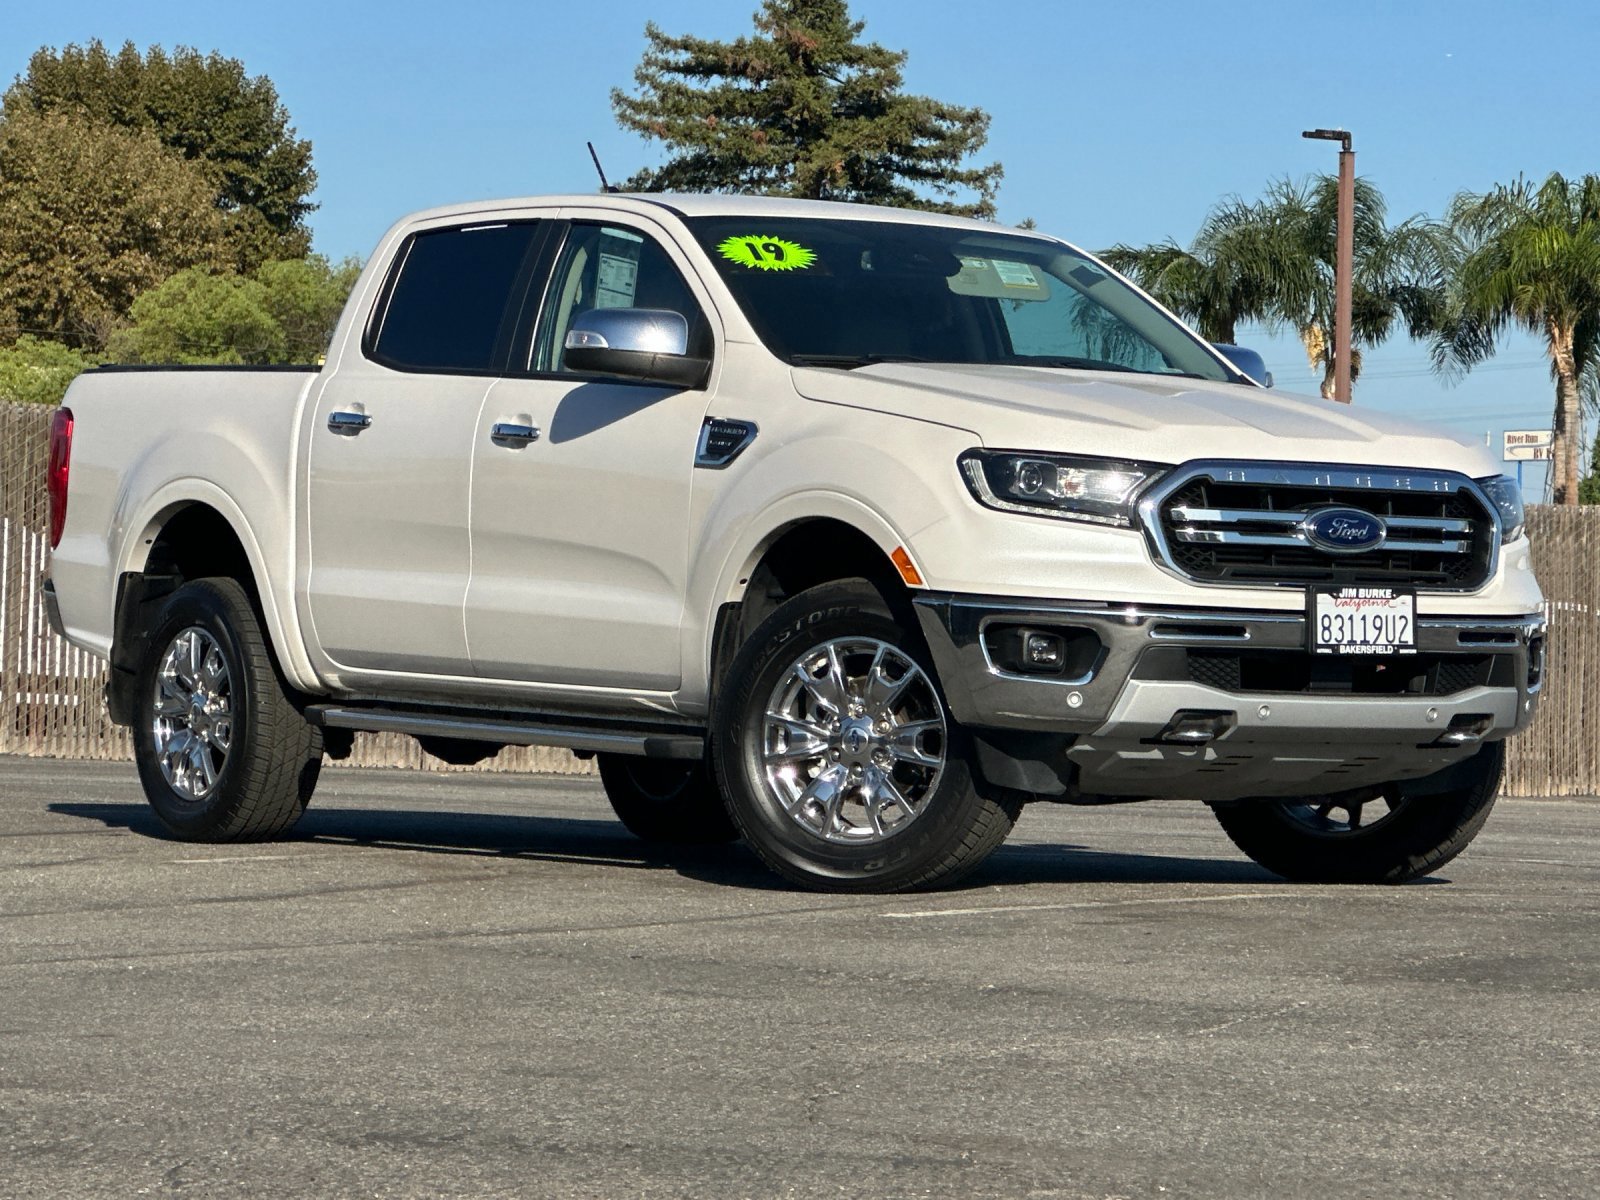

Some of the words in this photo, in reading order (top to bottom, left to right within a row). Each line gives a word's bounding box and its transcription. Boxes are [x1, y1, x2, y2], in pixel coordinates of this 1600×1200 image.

[745, 242, 786, 262] 19
[1507, 434, 1524, 444] River
[1328, 517, 1369, 540] Ford
[1339, 588, 1357, 598] JIM
[1358, 589, 1393, 598] BURKE
[1334, 598, 1397, 612] California
[1321, 613, 1409, 644] 83119U2
[1339, 645, 1393, 654] BAKERSFIELD
